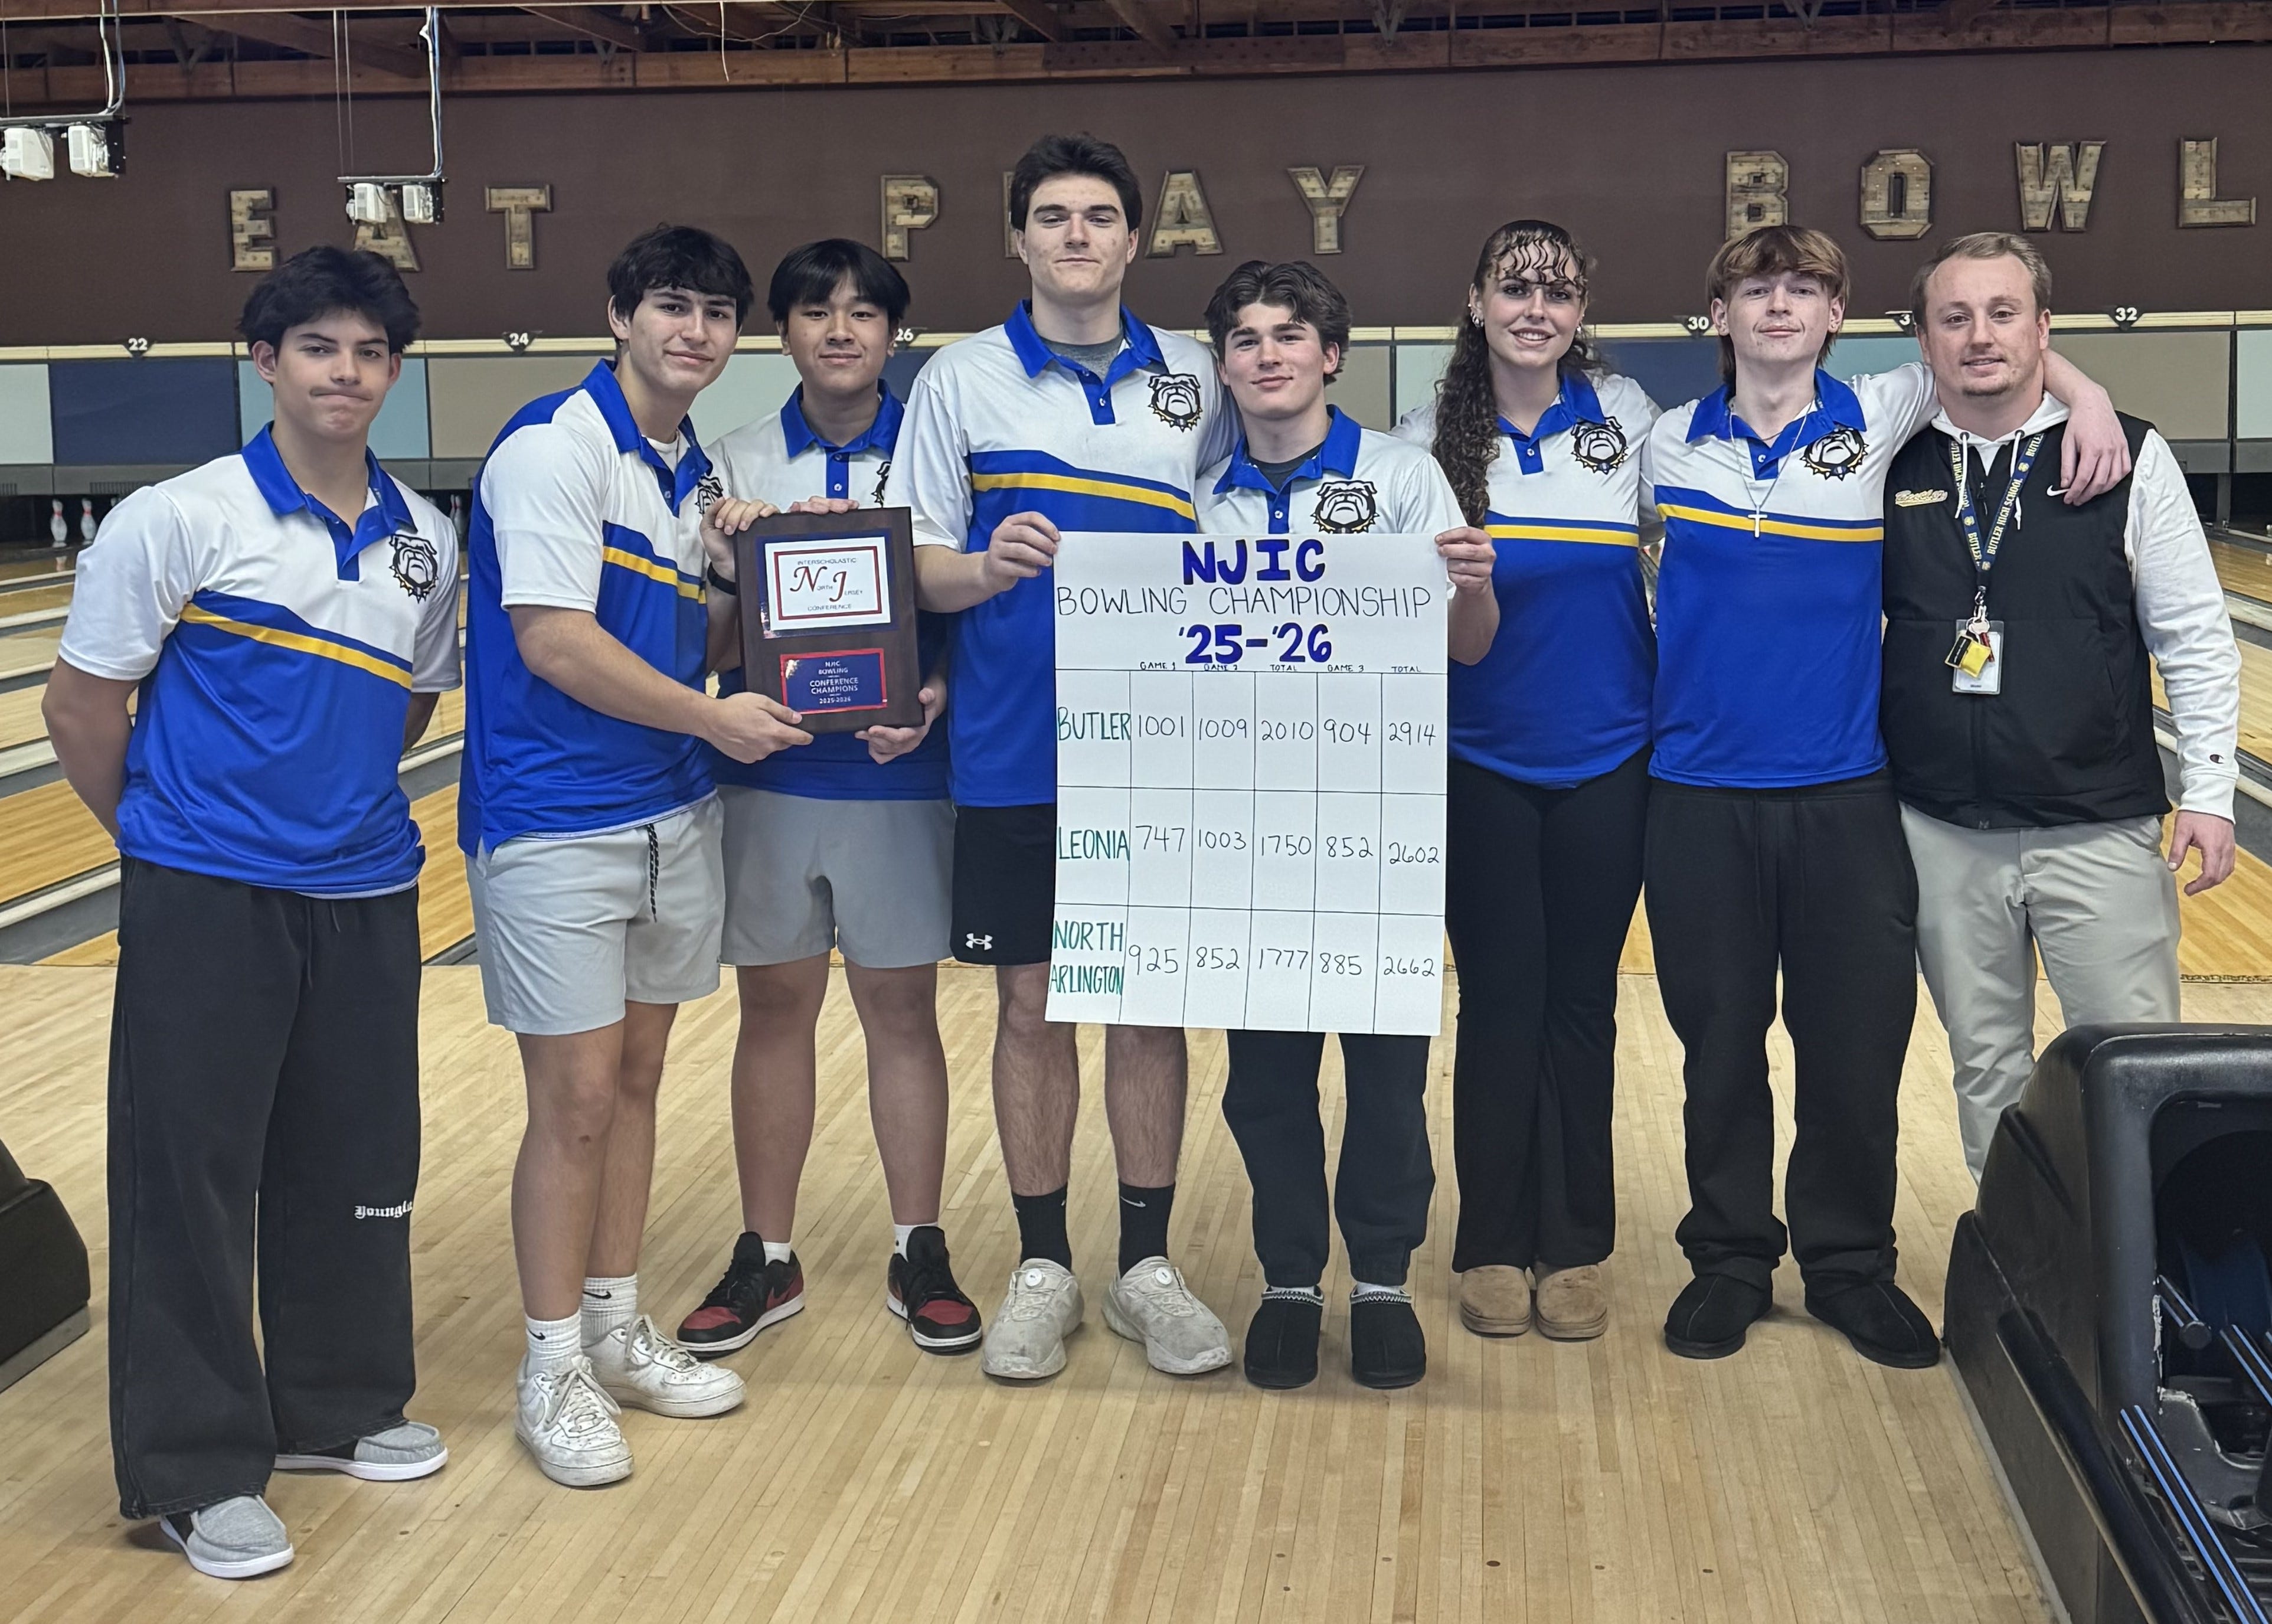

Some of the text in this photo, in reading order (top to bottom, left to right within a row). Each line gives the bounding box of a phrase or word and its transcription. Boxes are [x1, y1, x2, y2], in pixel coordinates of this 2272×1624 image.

[881, 165, 1365, 262] PAY
[1725, 137, 2256, 241] BOWL
[1688, 316, 1709, 330] 30
[1899, 313, 1911, 326] 3
[2115, 307, 2137, 322] 32
[128, 337, 148, 351] 22
[509, 332, 529, 345] 24
[894, 328, 914, 342] 26
[1987, 478, 2023, 556] BUTLER HIGH SCHOOL
[1967, 531, 1982, 560] BUTLER
[1182, 538, 1326, 585] NJIC
[1057, 586, 1431, 618] BOWLING CHAMPIONSHIP
[1140, 661, 1168, 671] GAME
[1172, 662, 1176, 670] 1
[1204, 663, 1229, 672] GAME
[1327, 664, 1354, 672] GAME
[809, 677, 858, 687] CONFERENCE
[811, 685, 858, 695] CHAMPIONS
[1057, 707, 1436, 746] BUTLER 1001 1009 2010 904 2914
[1058, 825, 1440, 864] LEONIA 747 1003 1750 852 2602
[1054, 920, 1124, 952] NORTH
[1128, 945, 1435, 977] 925 852 1777 885 2662
[1049, 964, 1124, 995] ARLINGTON
